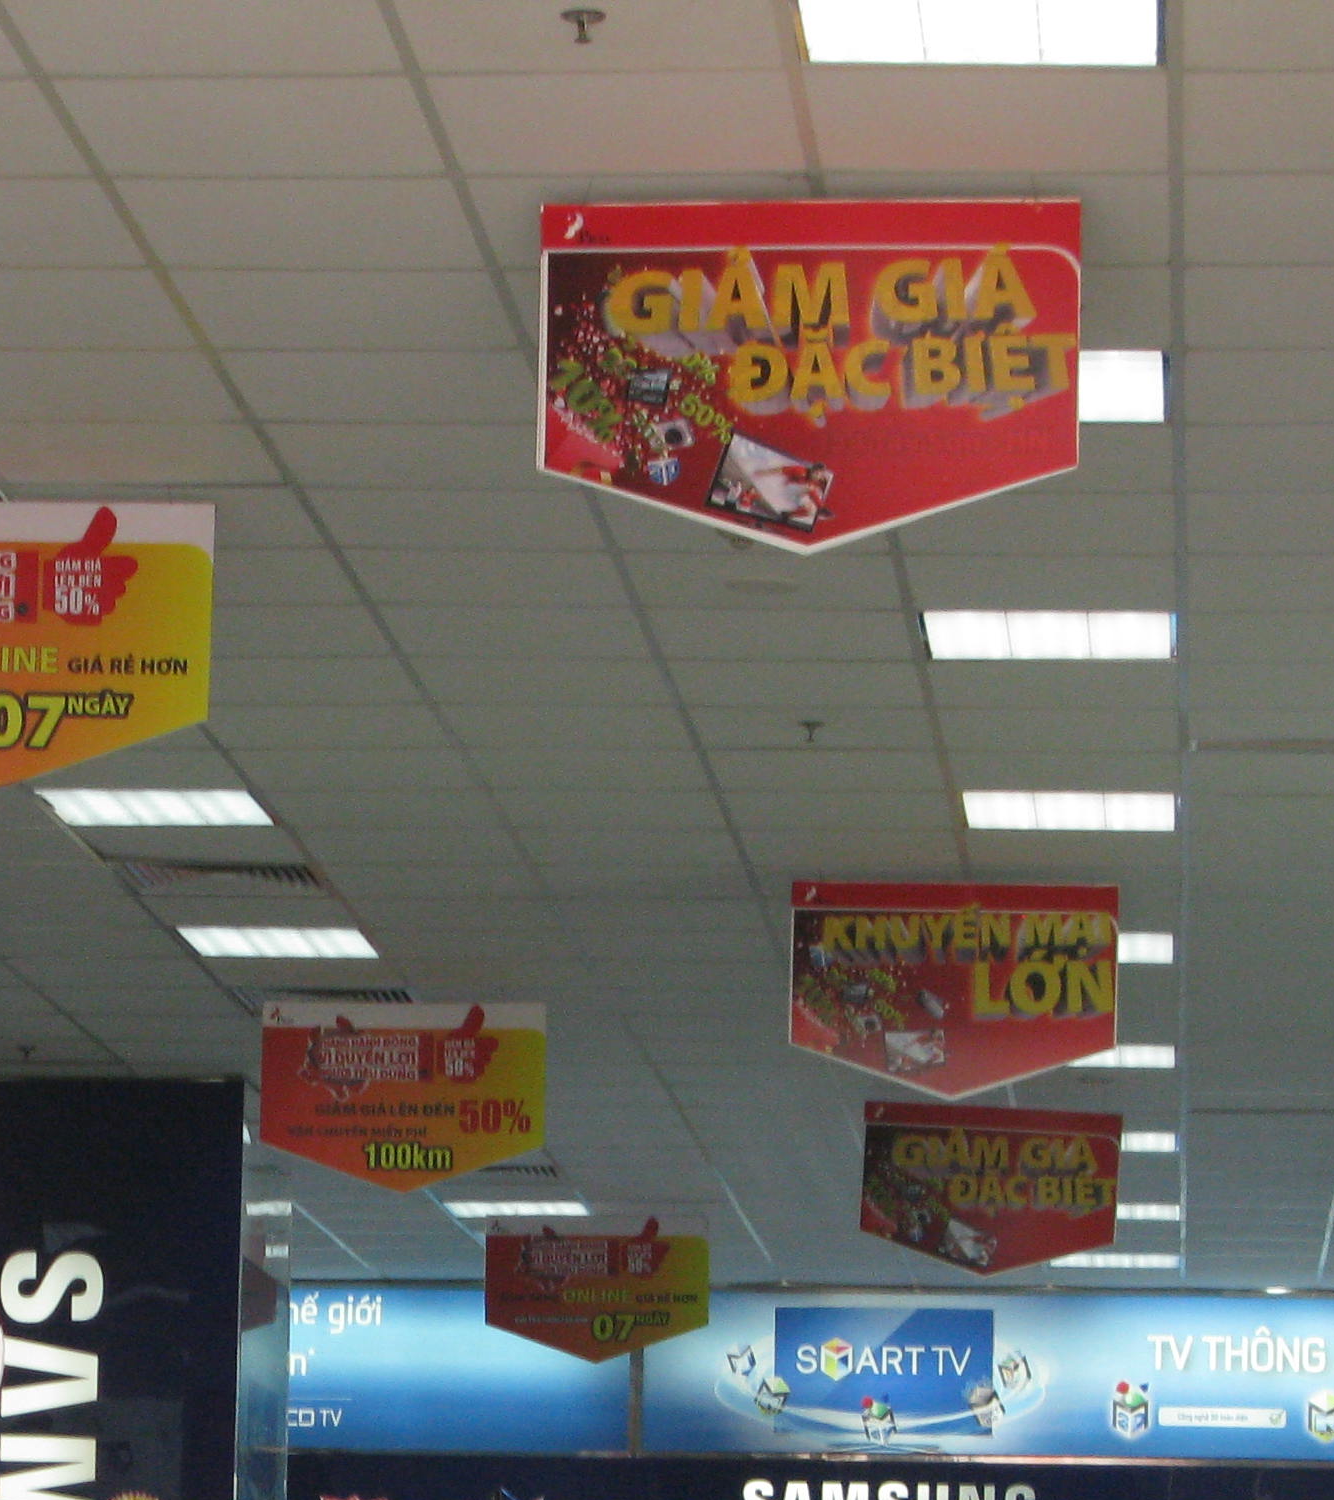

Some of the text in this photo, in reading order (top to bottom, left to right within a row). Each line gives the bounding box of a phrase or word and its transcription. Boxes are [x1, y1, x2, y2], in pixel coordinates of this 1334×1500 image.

[603, 242, 1037, 346] GIẢM GIÁ
[729, 322, 1077, 426] ĐẶC BIỆT
[54, 587, 100, 616] 50%
[68, 655, 103, 675] GIÁ
[141, 656, 188, 677] HƠN
[67, 688, 134, 719] NGÀY
[972, 950, 1115, 1016] LỚN
[458, 1098, 532, 1136] 50%
[364, 1140, 454, 1172] 100km
[328, 1293, 383, 1336] giới
[591, 1311, 636, 1342] 07
[931, 1346, 972, 1377] TV
[1147, 1336, 1194, 1372] TV
[1204, 1327, 1327, 1376] THÔNG
[318, 1406, 343, 1428] TV
